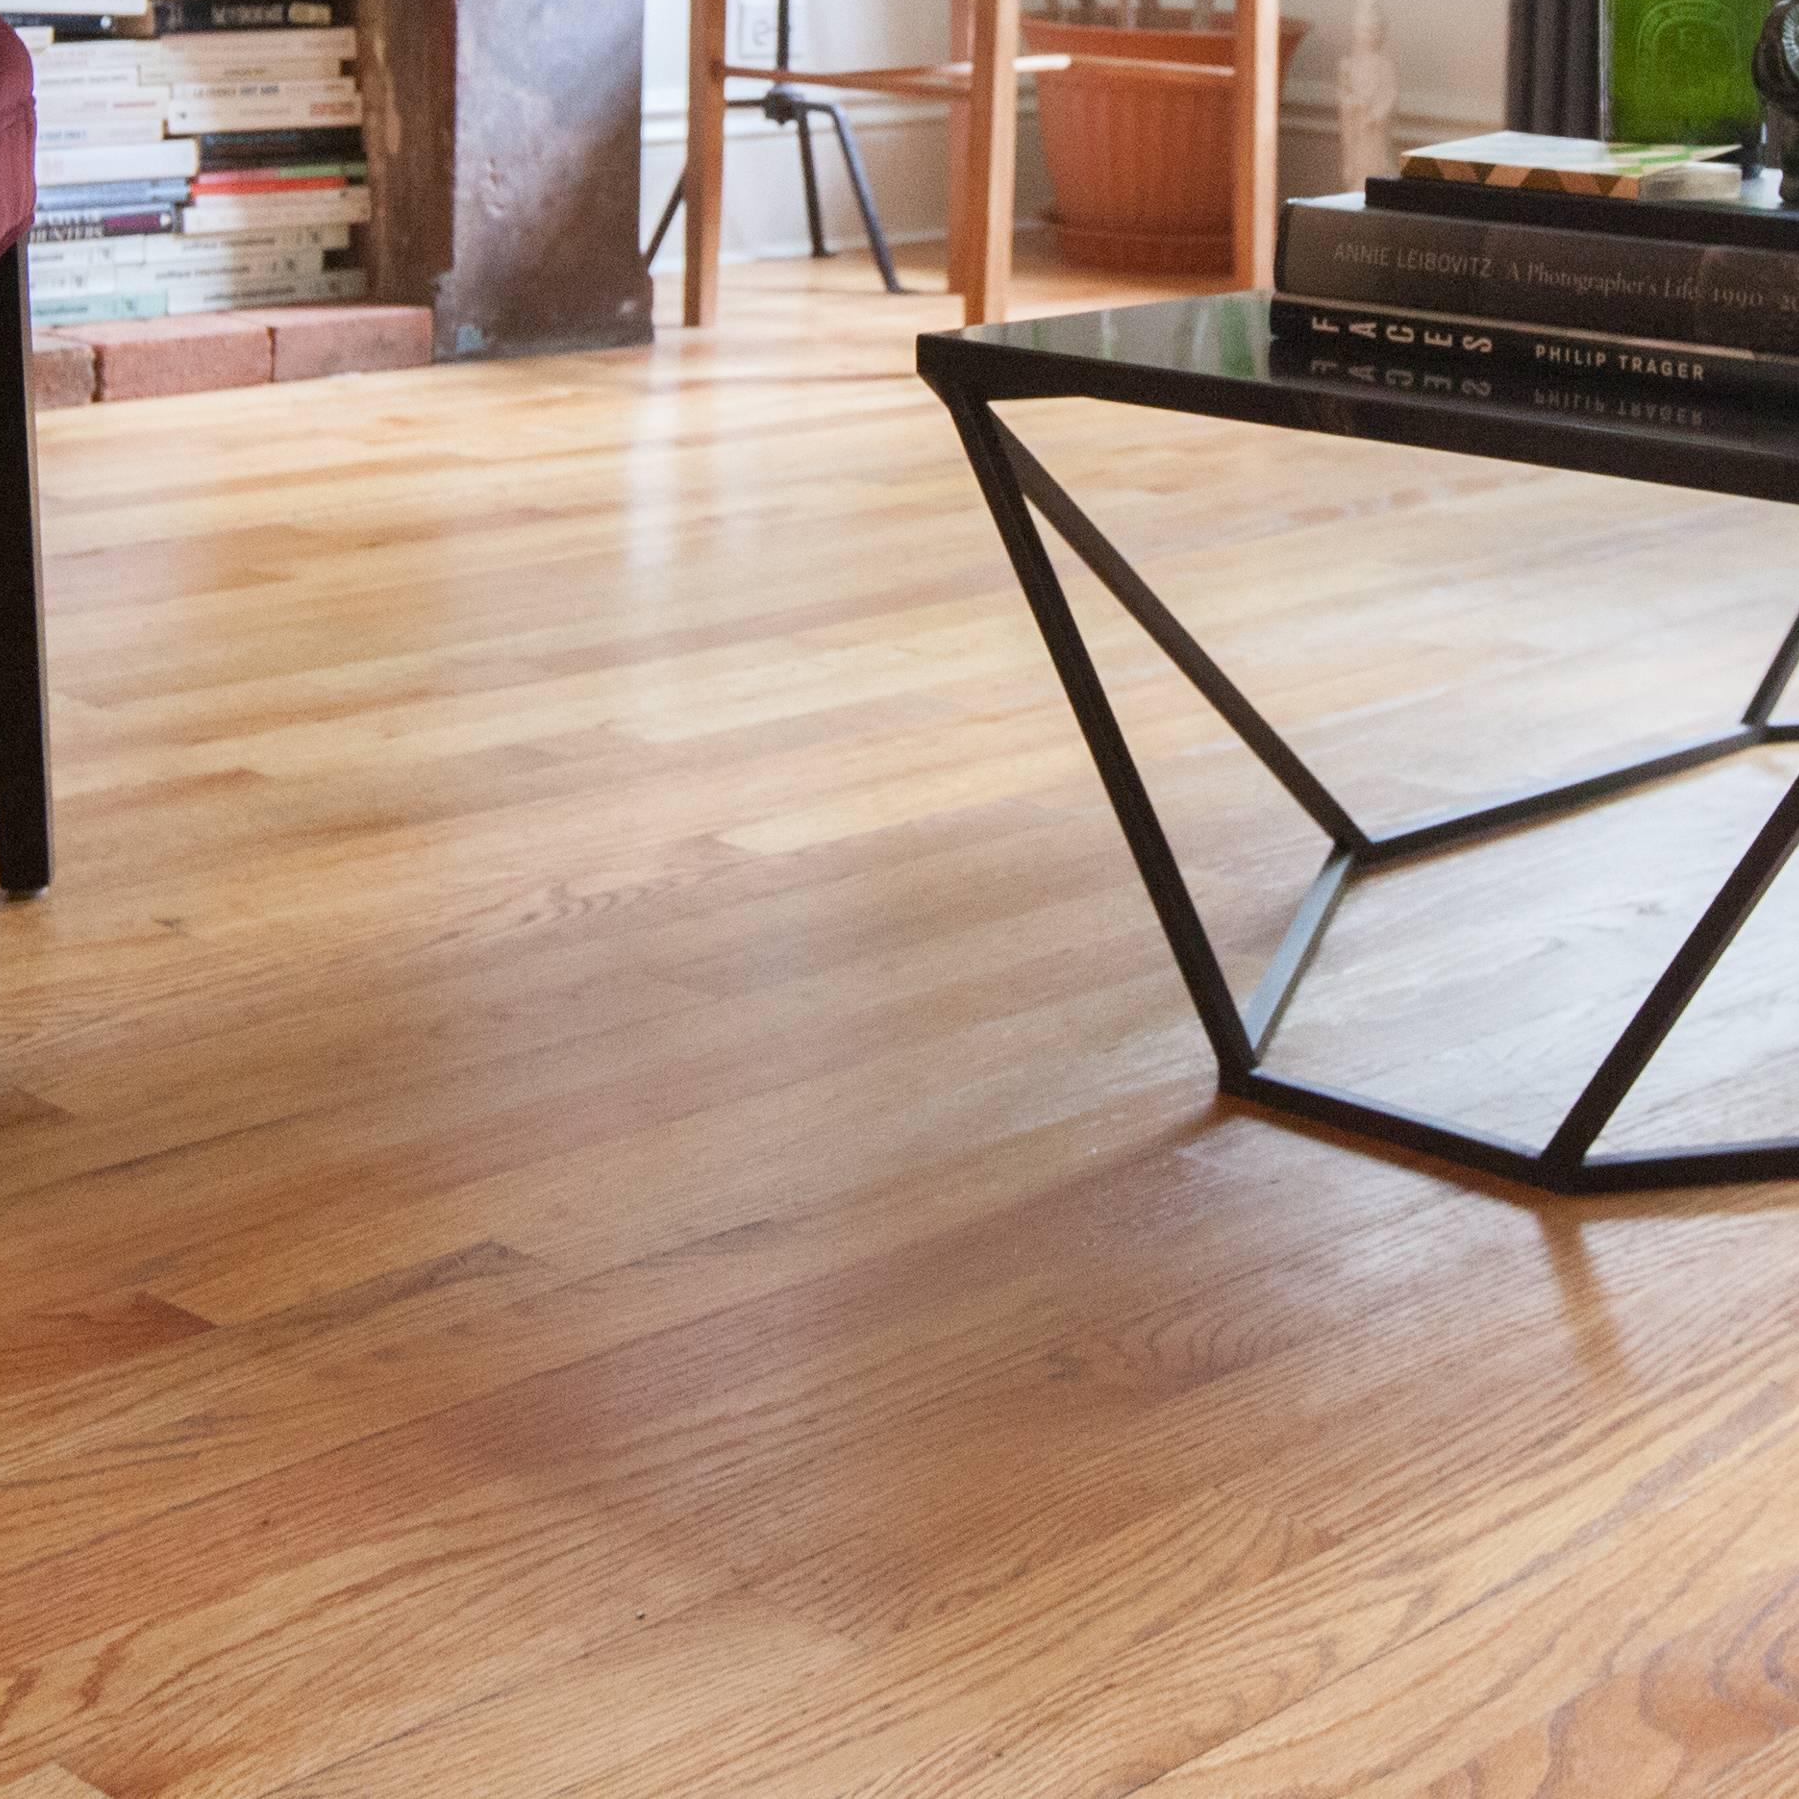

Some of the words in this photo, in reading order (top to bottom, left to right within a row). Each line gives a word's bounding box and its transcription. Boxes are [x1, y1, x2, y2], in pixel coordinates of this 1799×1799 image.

[1333, 242, 1390, 267] ANNIE
[1396, 247, 1493, 278] LEIBOVITZ
[1505, 261, 1519, 281] A
[1311, 316, 1493, 353] FACES
[1535, 344, 1606, 367] PHILIP
[1618, 354, 1704, 381] TRAGER
